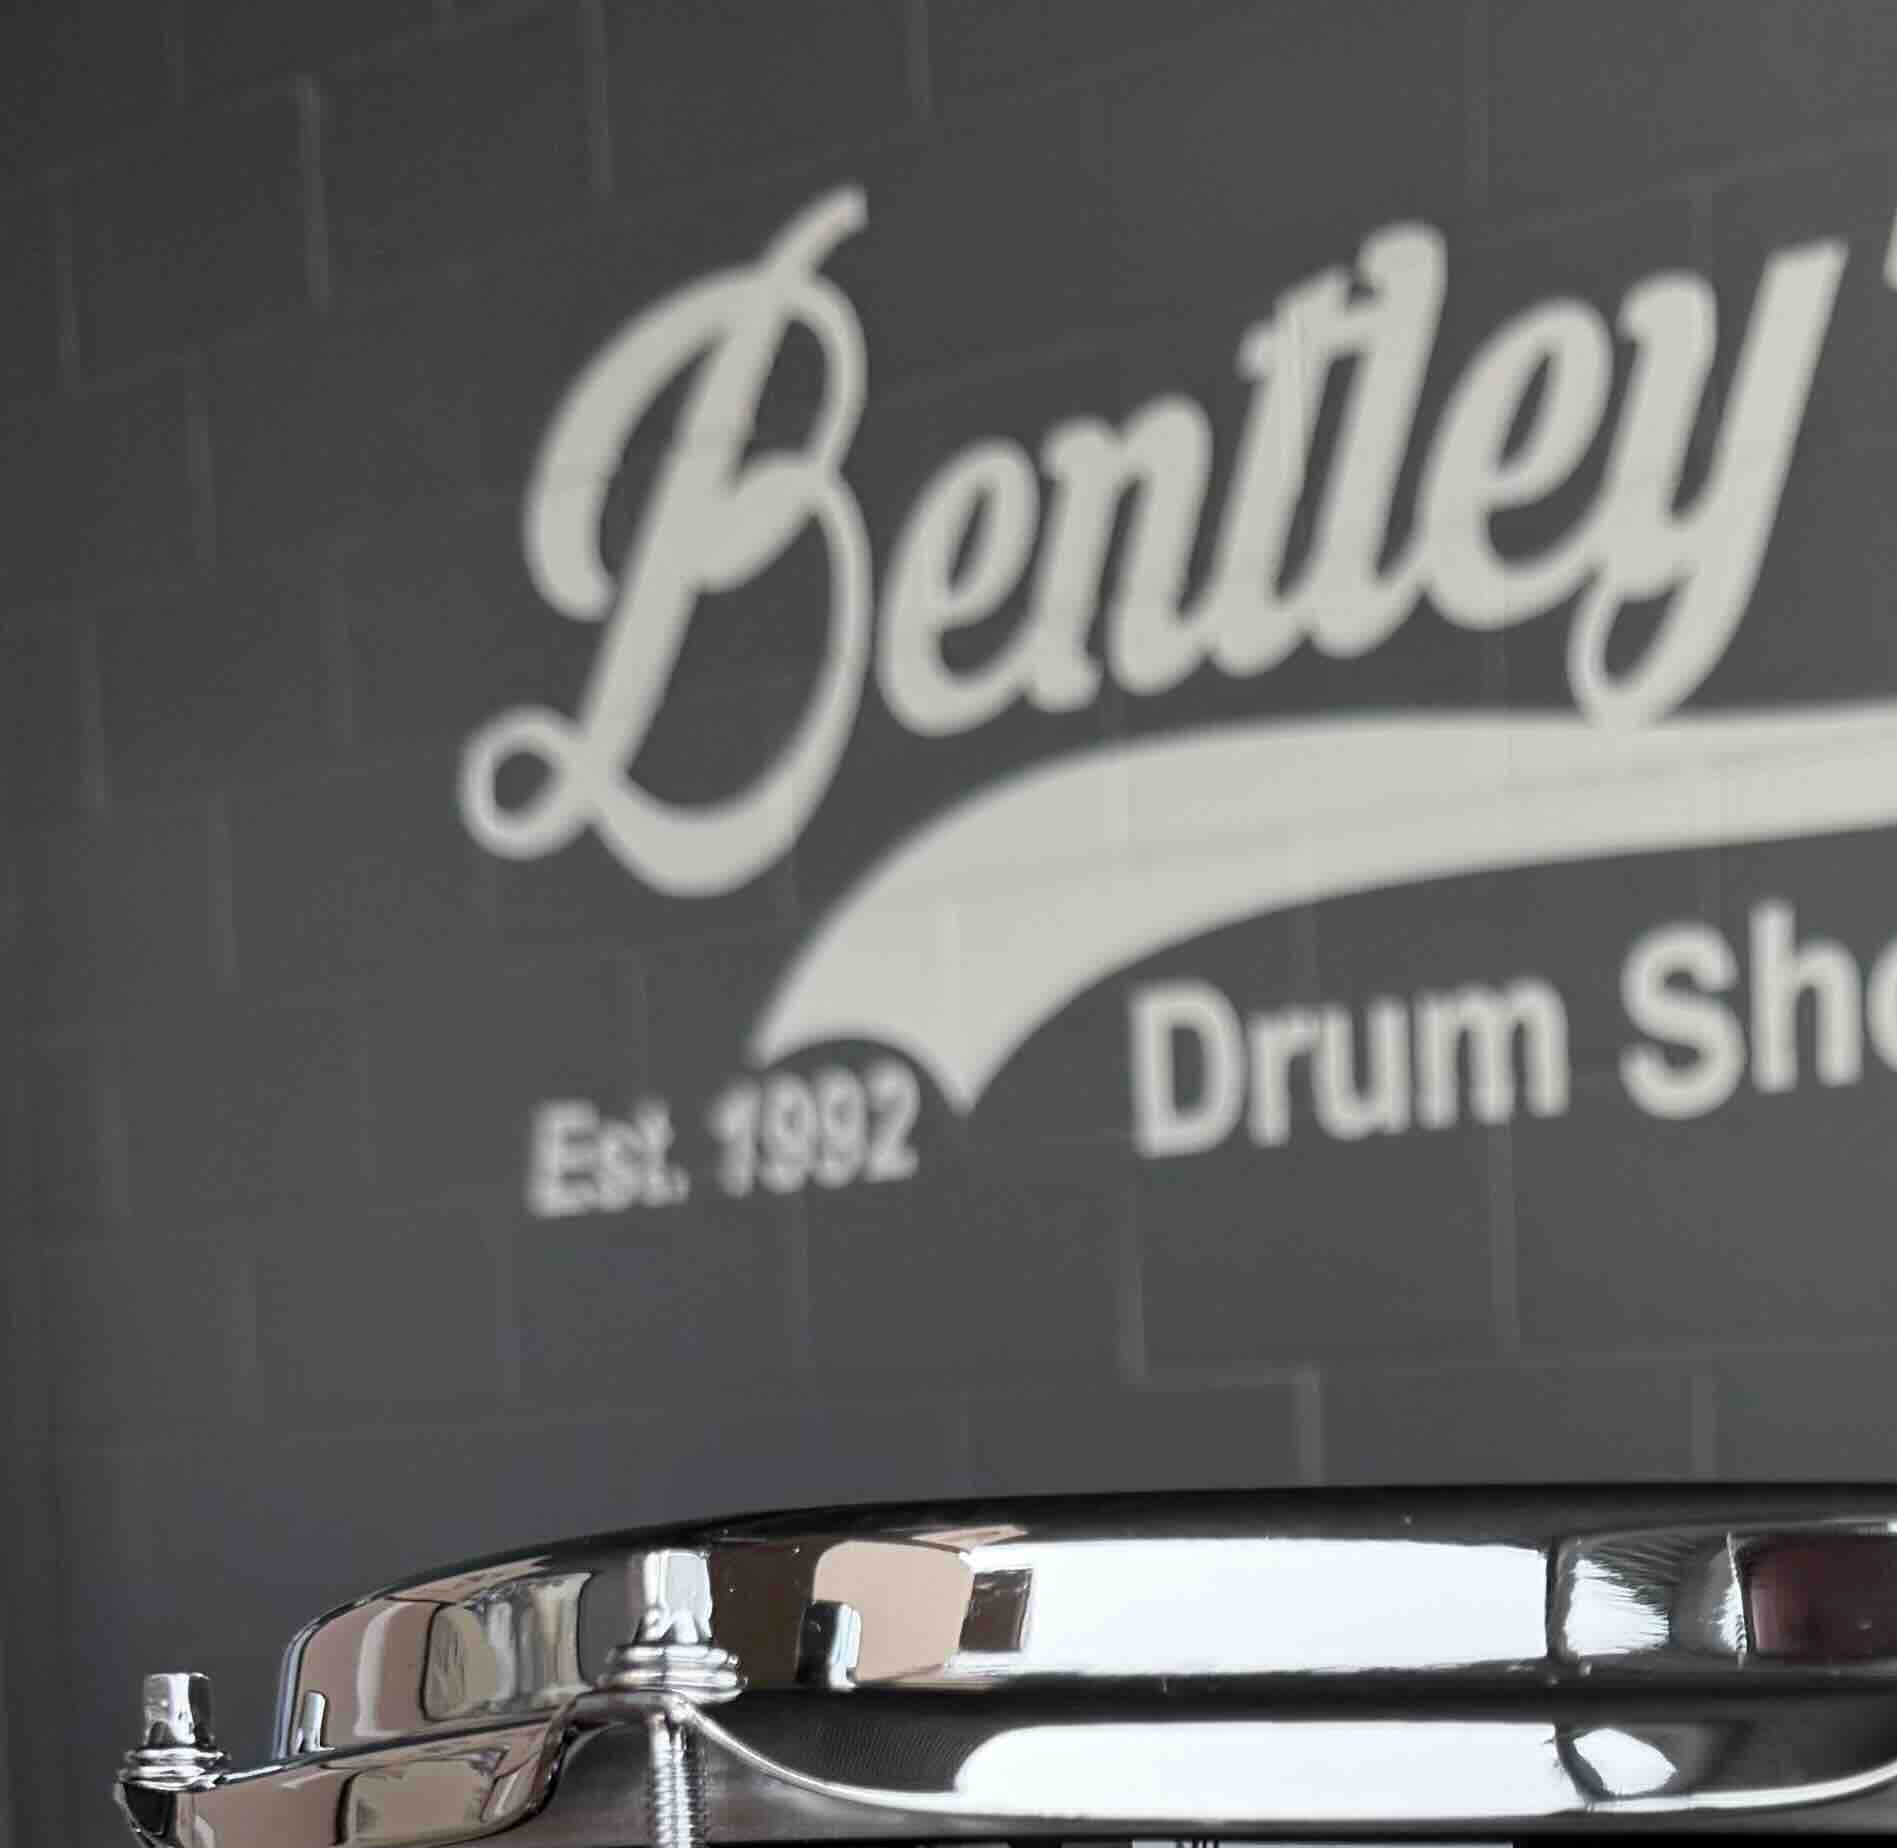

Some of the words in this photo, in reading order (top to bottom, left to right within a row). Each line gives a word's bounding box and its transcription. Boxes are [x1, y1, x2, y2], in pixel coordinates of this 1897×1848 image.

[528, 1097, 692, 1218] Est.
[710, 1058, 920, 1198] 1992
[1130, 978, 1569, 1158] Drum
